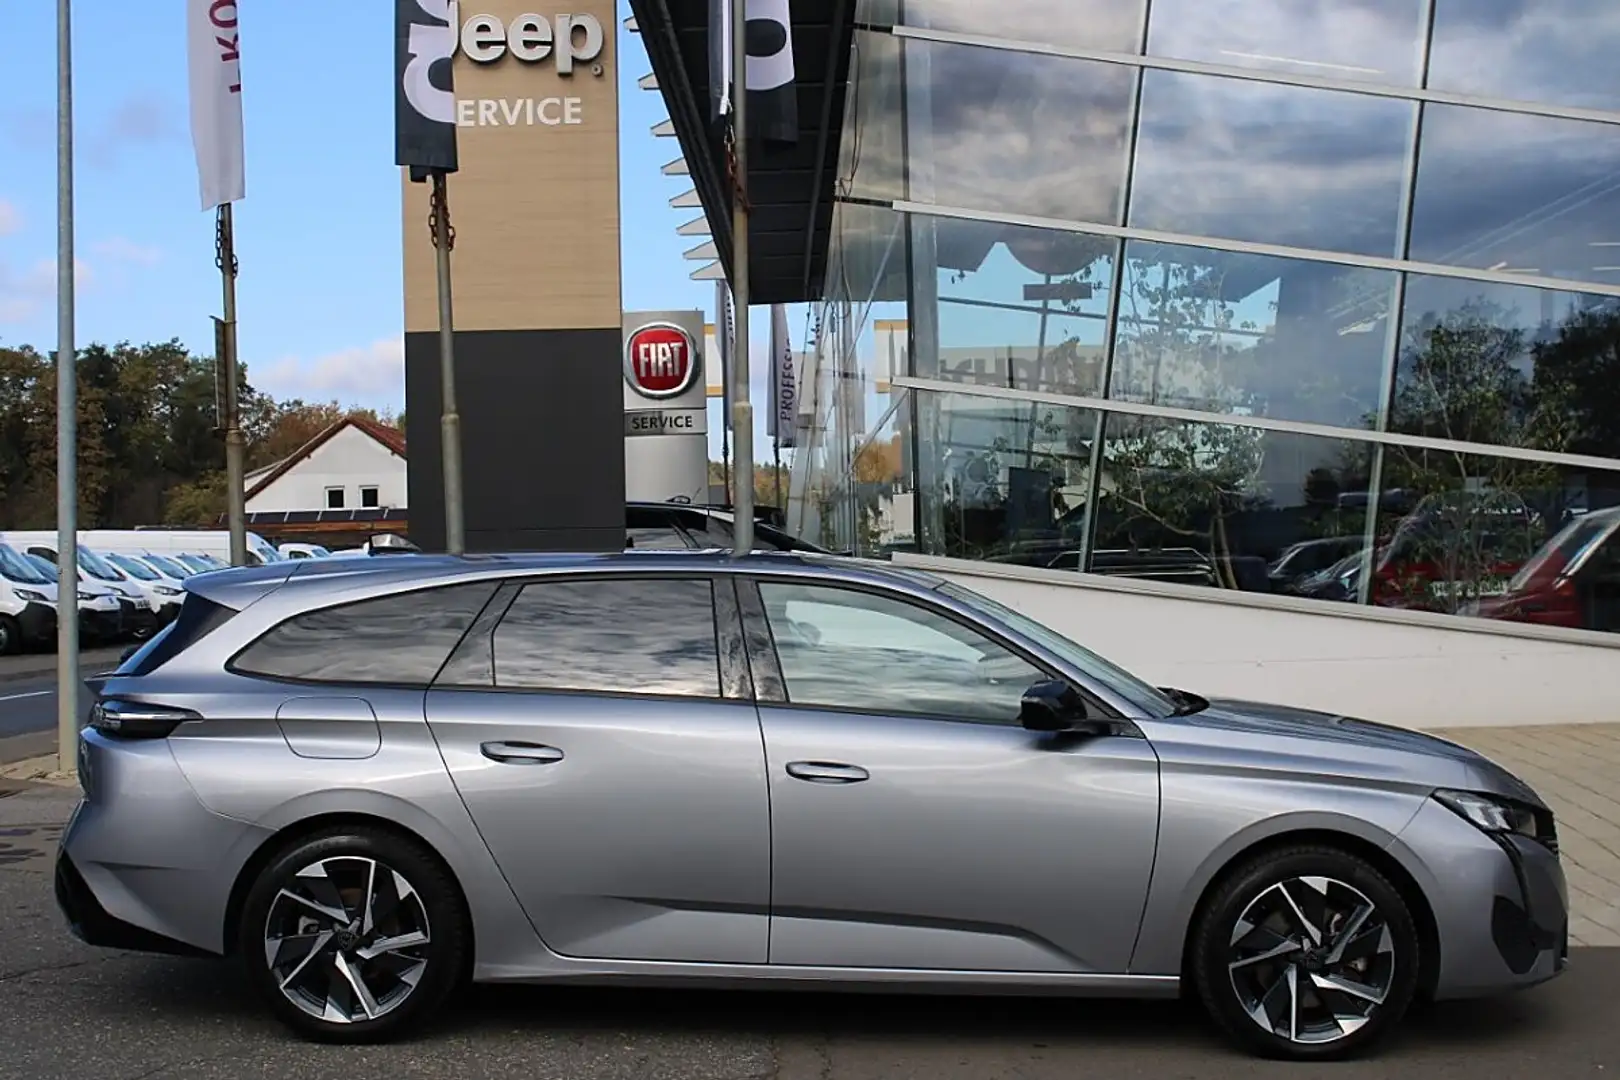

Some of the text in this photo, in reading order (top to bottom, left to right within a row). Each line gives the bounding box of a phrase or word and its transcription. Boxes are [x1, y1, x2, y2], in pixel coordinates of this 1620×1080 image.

[456, 97, 583, 127] ERVICE
[638, 341, 684, 378] FIAT
[631, 414, 694, 430] SERVICE
